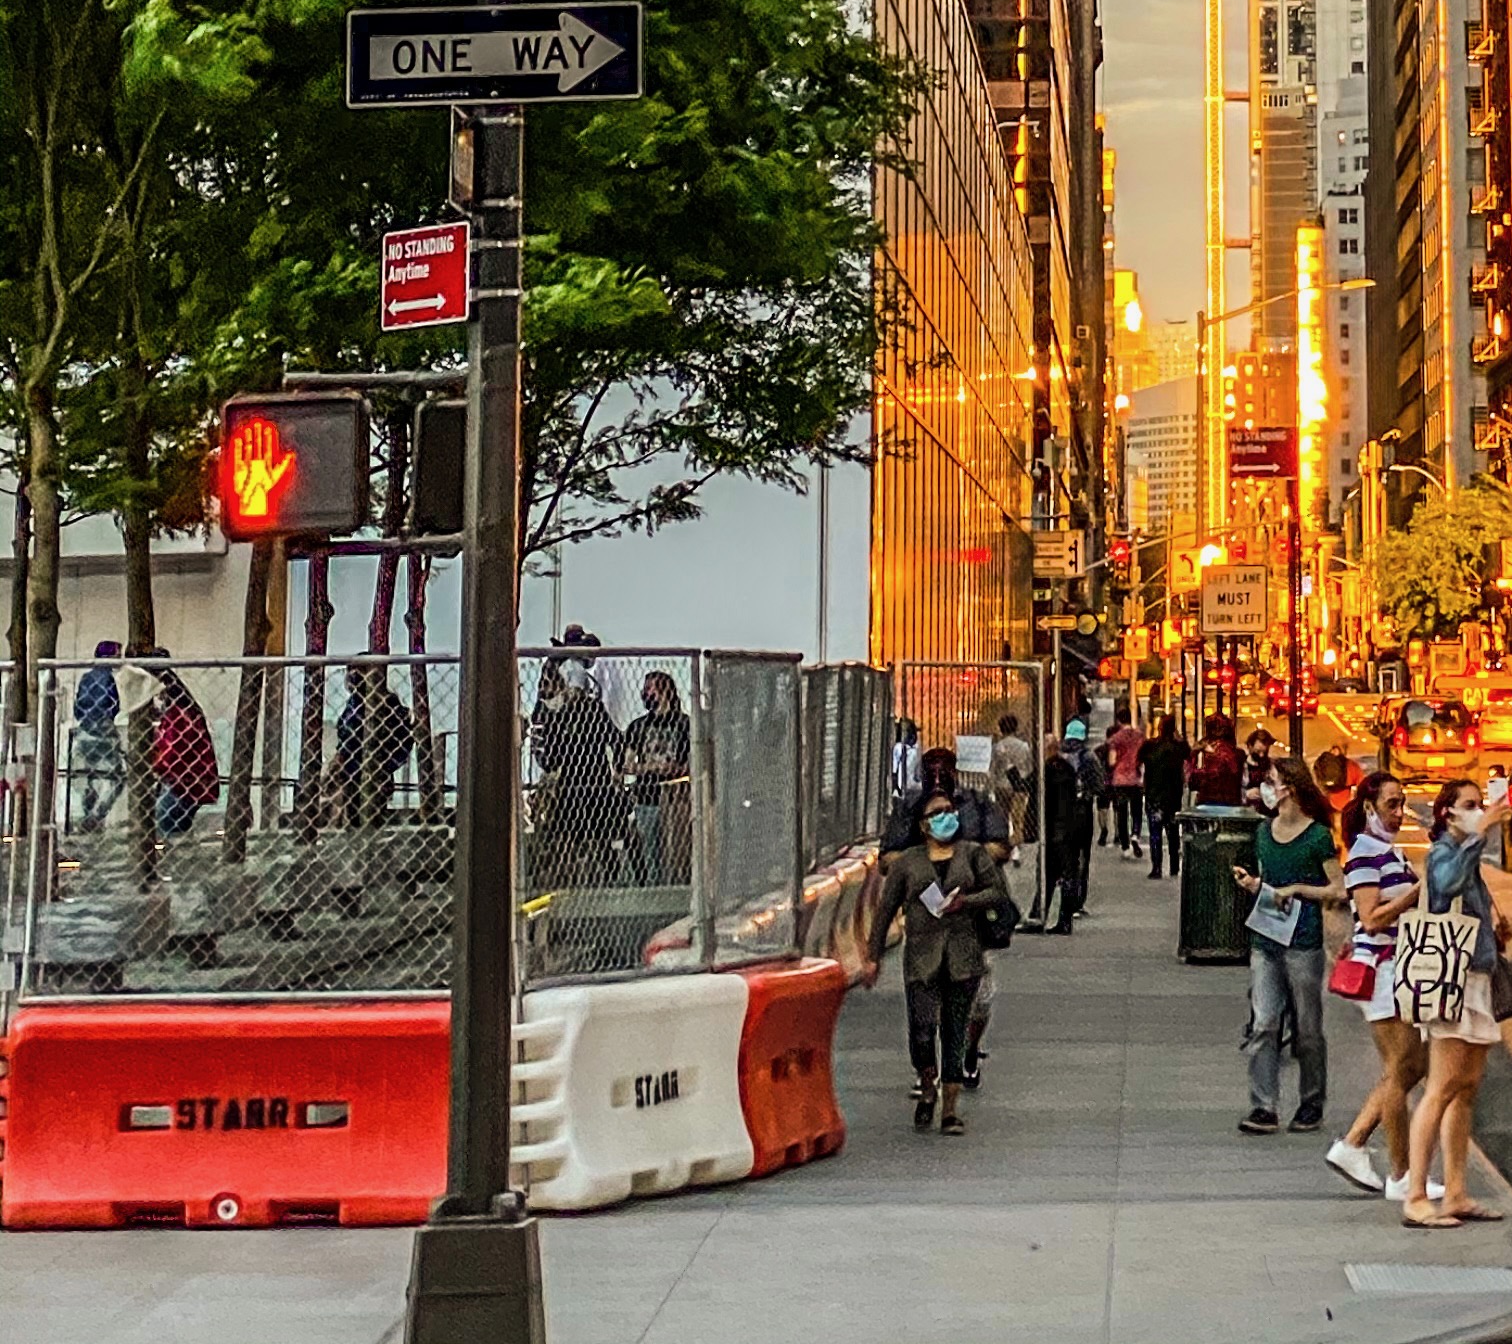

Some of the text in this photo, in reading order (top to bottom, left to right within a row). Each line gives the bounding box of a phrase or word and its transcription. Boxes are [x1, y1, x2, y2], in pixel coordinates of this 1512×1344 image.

[392, 34, 595, 74] ONE WAY
[388, 234, 454, 260] NO STANDING
[388, 262, 430, 285] Anytime
[1207, 573, 1261, 585] LEFT LANE
[1217, 592, 1250, 605] MUST
[1207, 613, 1262, 625] TURN LEFT
[1403, 919, 1474, 955] NEW
[635, 1069, 679, 1109] STARR
[176, 1097, 289, 1131] STARR
